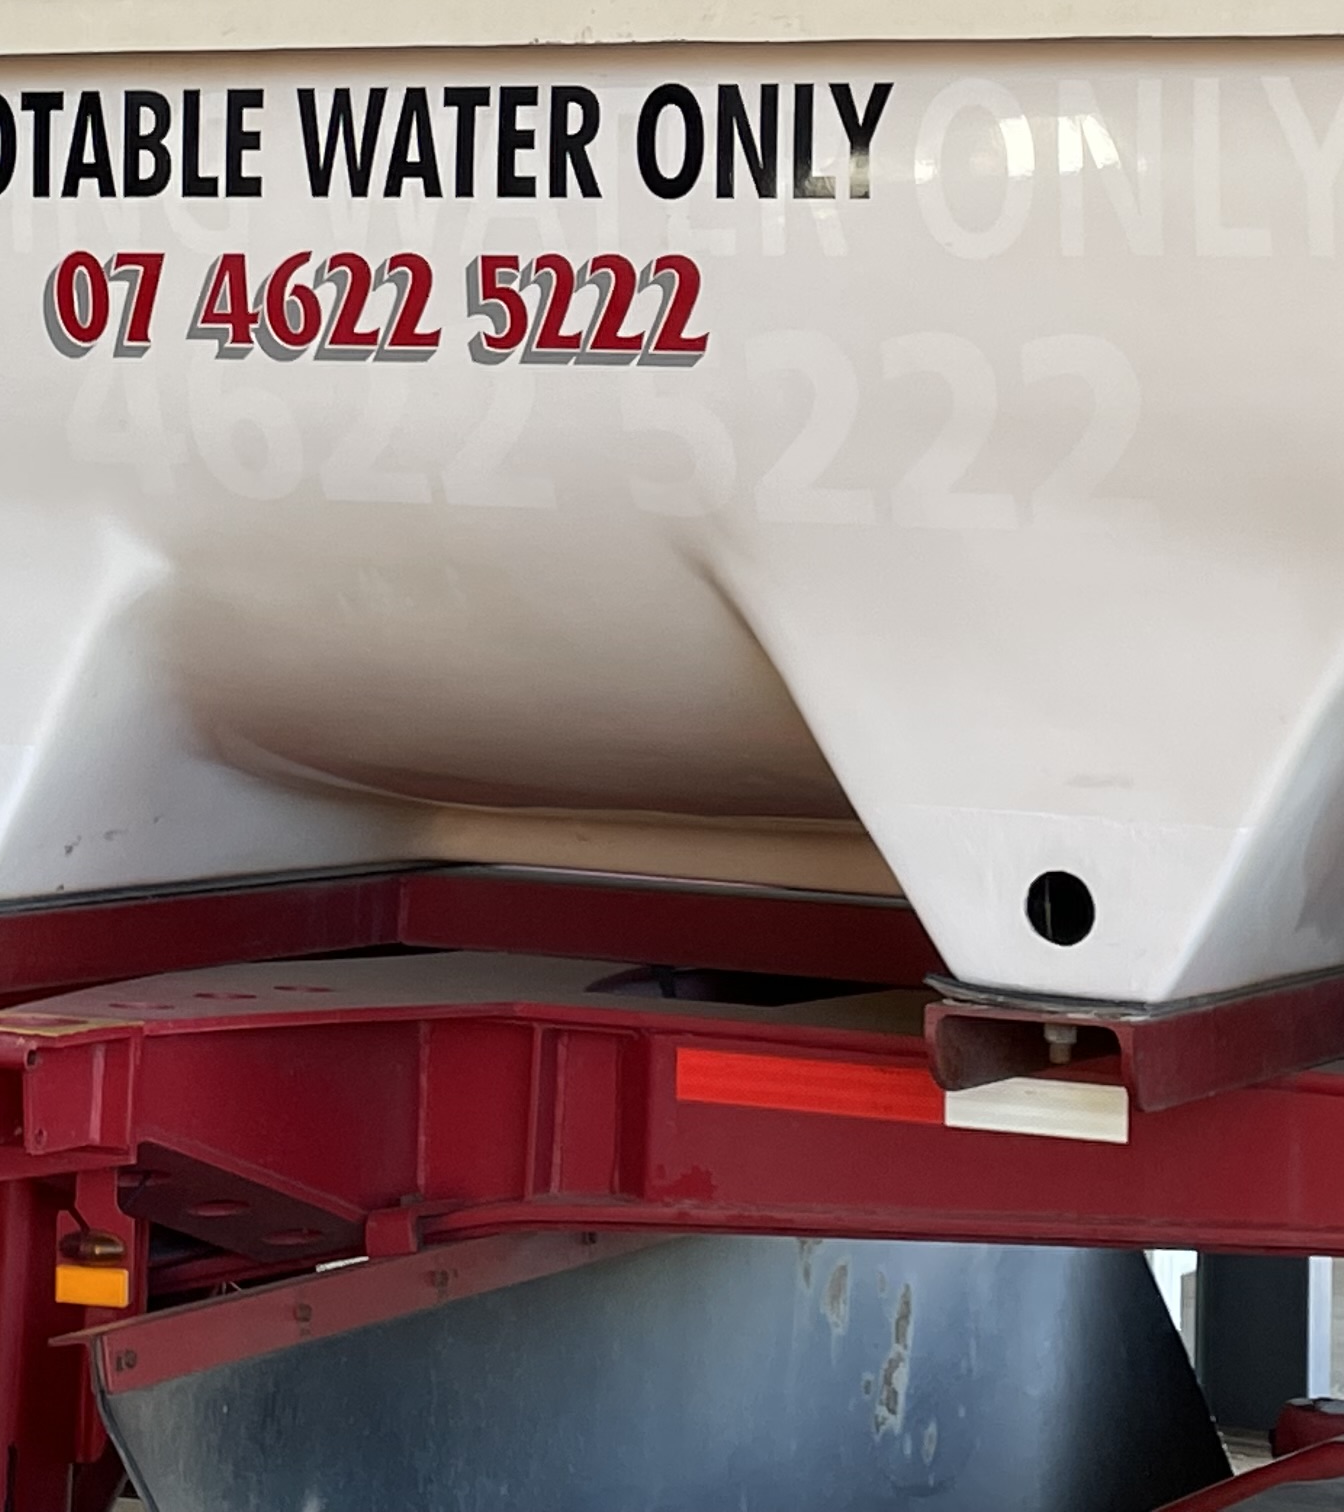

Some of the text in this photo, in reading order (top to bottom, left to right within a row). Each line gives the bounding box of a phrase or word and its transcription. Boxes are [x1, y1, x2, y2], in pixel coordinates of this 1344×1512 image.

[297, 85, 602, 200] WATER
[635, 80, 895, 200] ONLY
[41, 248, 712, 369] 07 4622 5222
